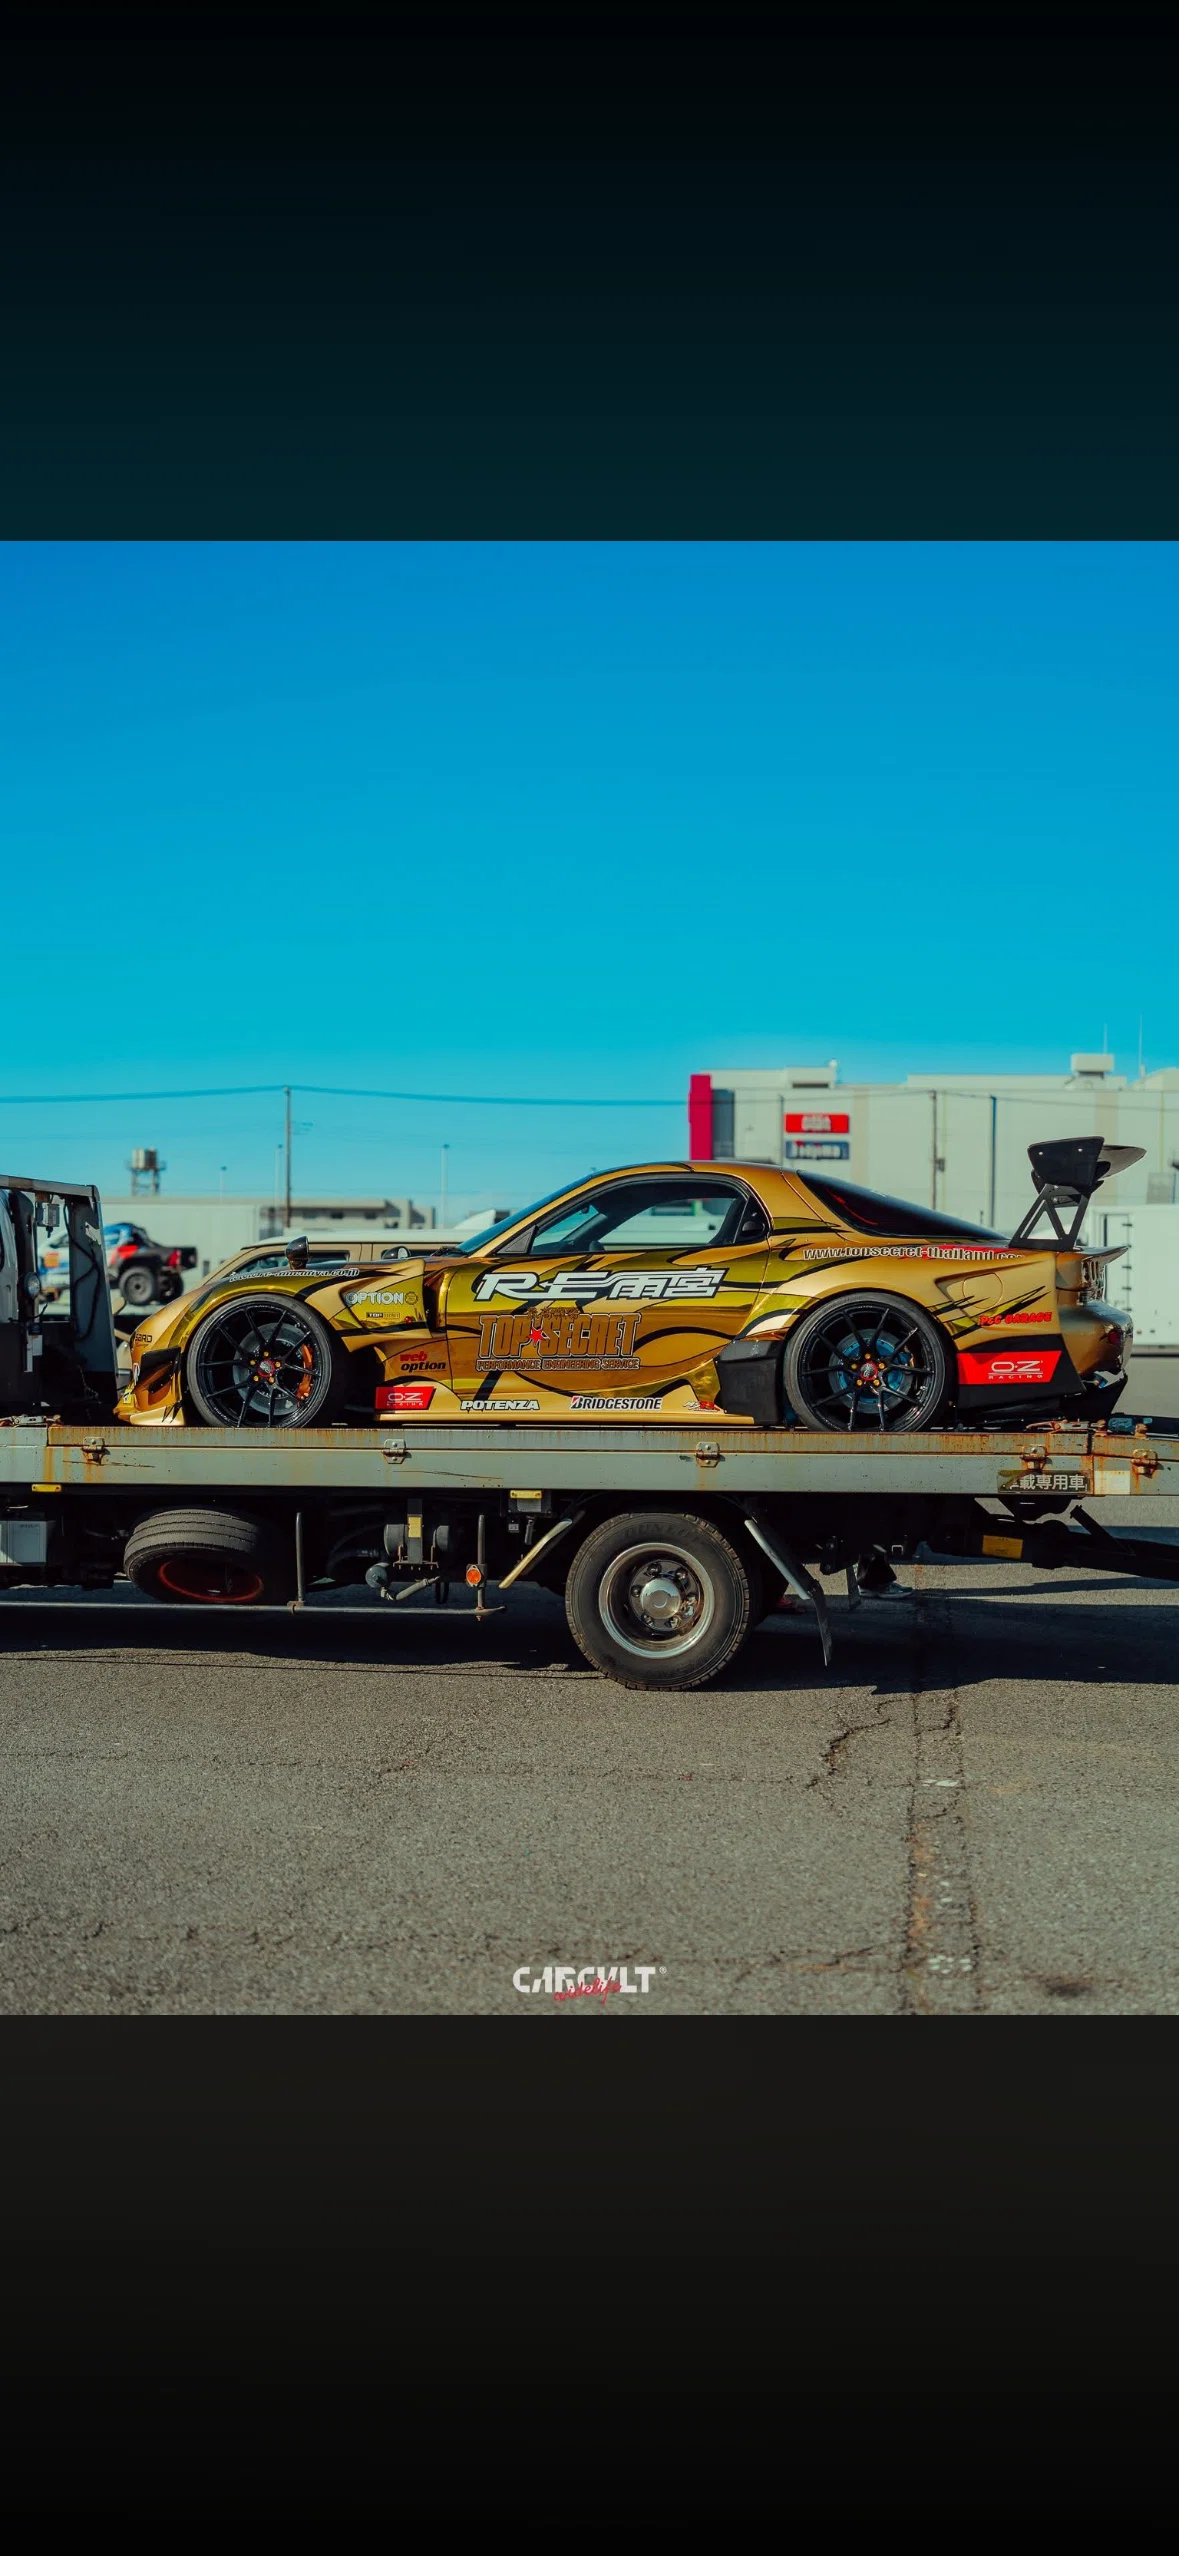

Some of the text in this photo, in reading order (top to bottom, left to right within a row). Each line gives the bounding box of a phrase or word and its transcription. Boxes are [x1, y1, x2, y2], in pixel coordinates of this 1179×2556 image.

[345, 1291, 404, 1305] OPTION
[1005, 1312, 1052, 1324] GARAGE
[479, 1312, 642, 1359] TOP SECRET
[400, 1351, 427, 1362] web
[401, 1361, 446, 1372] option
[476, 1358, 640, 1371] PERFORMANCE ENGINEERING SERVICE
[460, 1400, 539, 1411] POTENZA
[570, 1396, 663, 1411] BRIDGESTONE
[1002, 1474, 1086, 1491] 載専用車
